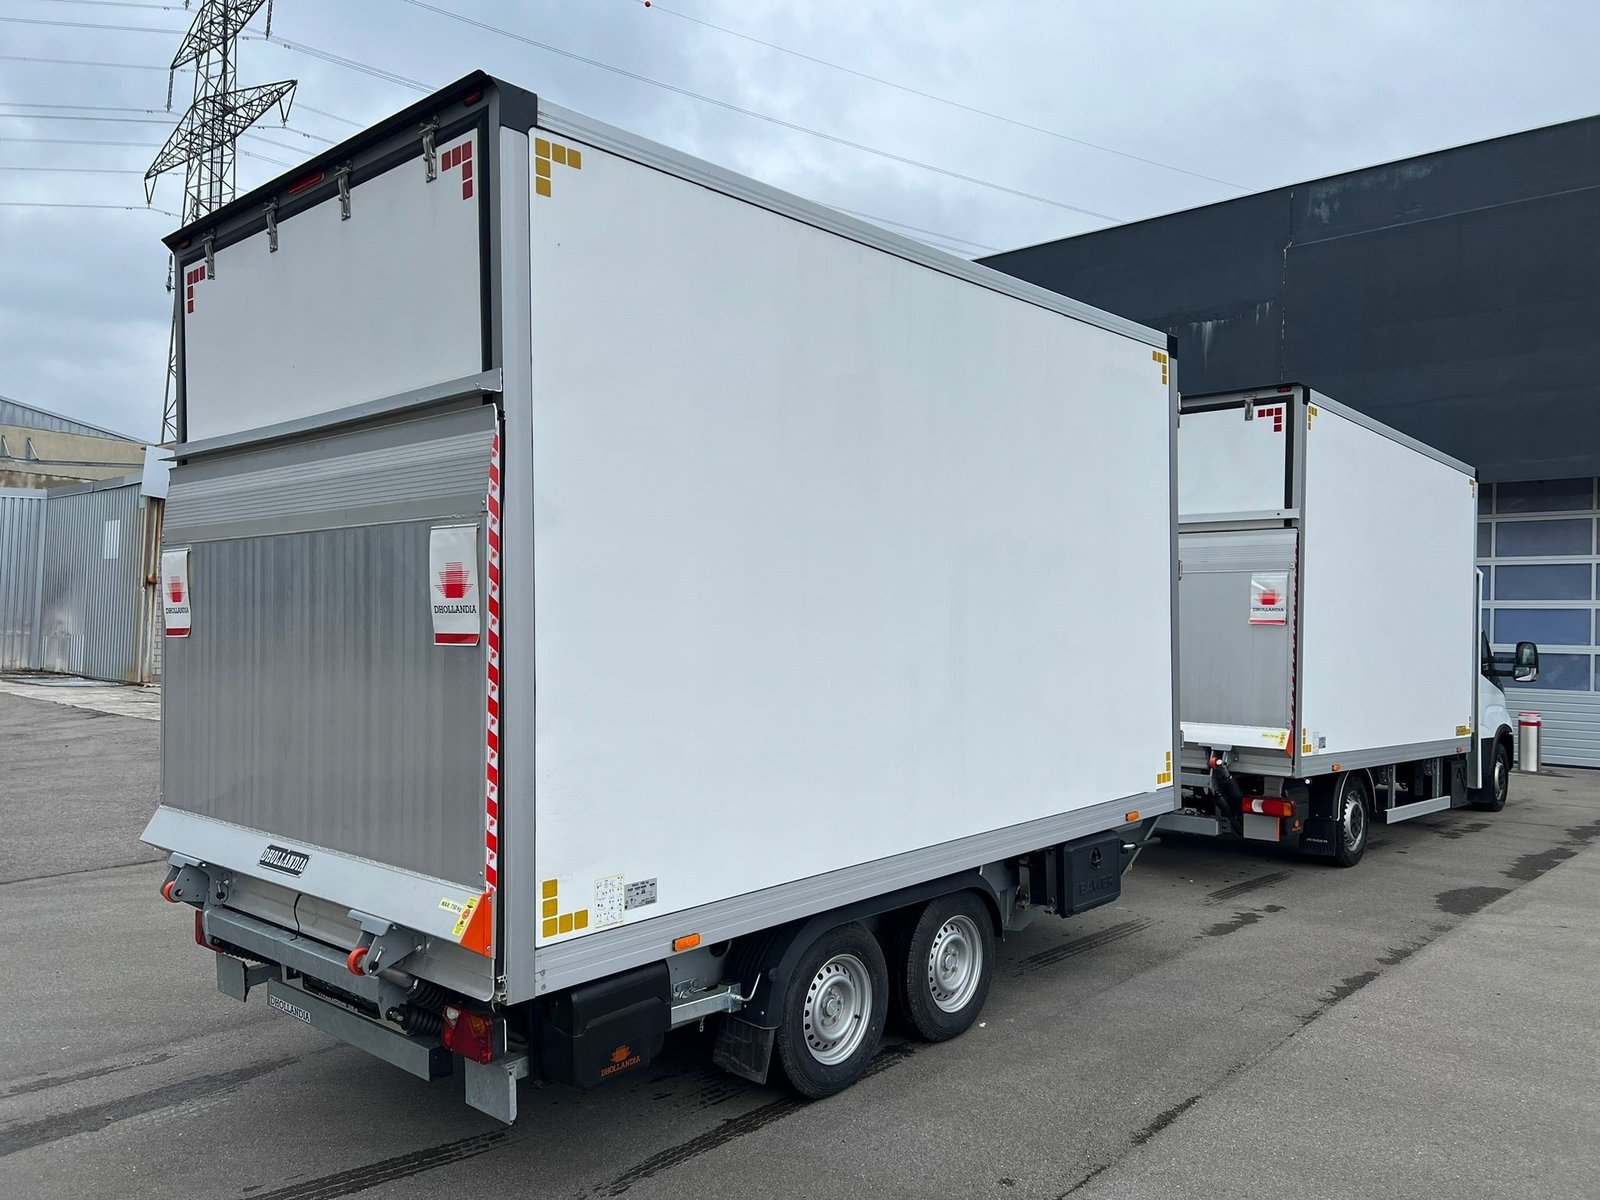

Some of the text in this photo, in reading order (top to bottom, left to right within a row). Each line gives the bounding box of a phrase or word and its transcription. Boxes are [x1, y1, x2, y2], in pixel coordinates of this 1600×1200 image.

[434, 605, 477, 613] DHOLLANDIA
[261, 848, 308, 871] DHOLLANDIA
[270, 996, 310, 1021] DHOLLANDIA
[600, 1055, 641, 1077] DHOLLANDIA
